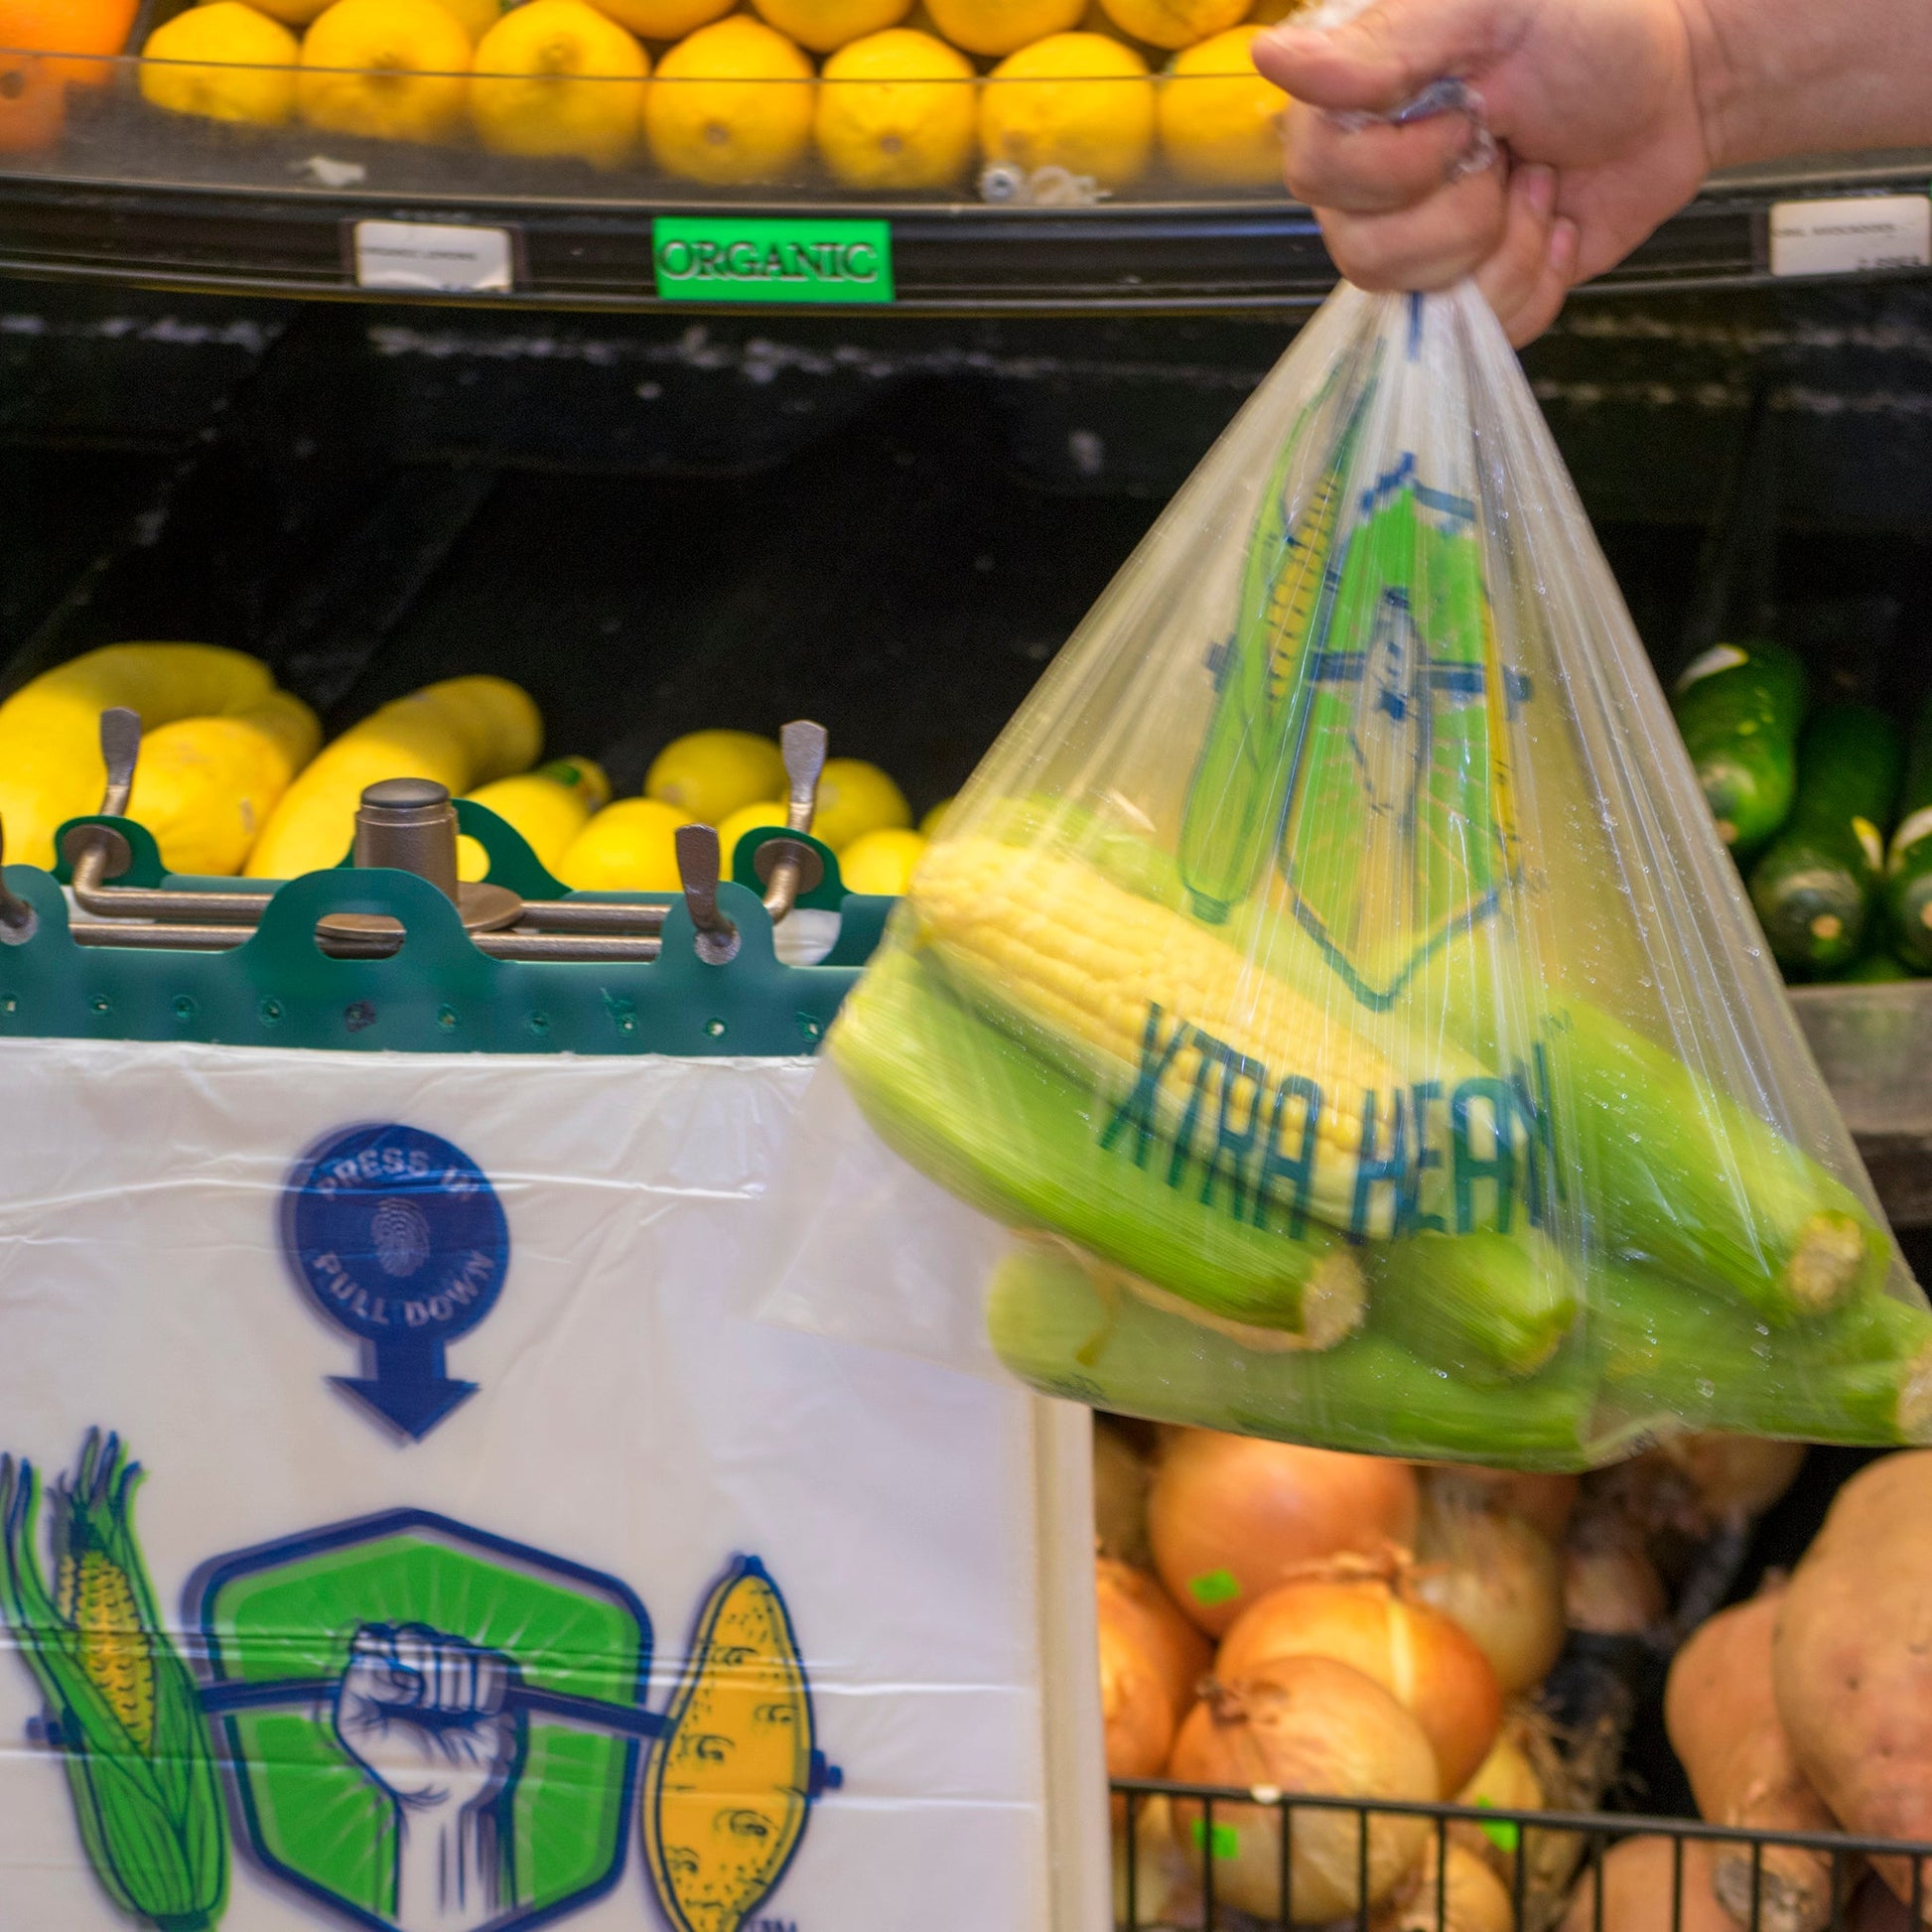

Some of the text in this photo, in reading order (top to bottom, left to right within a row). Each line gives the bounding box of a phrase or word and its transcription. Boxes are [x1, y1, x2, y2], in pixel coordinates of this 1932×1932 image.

[659, 241, 878, 284] ORGANIC
[316, 1147, 431, 1201] PRESS
[313, 1250, 494, 1327] PULL DOWN
